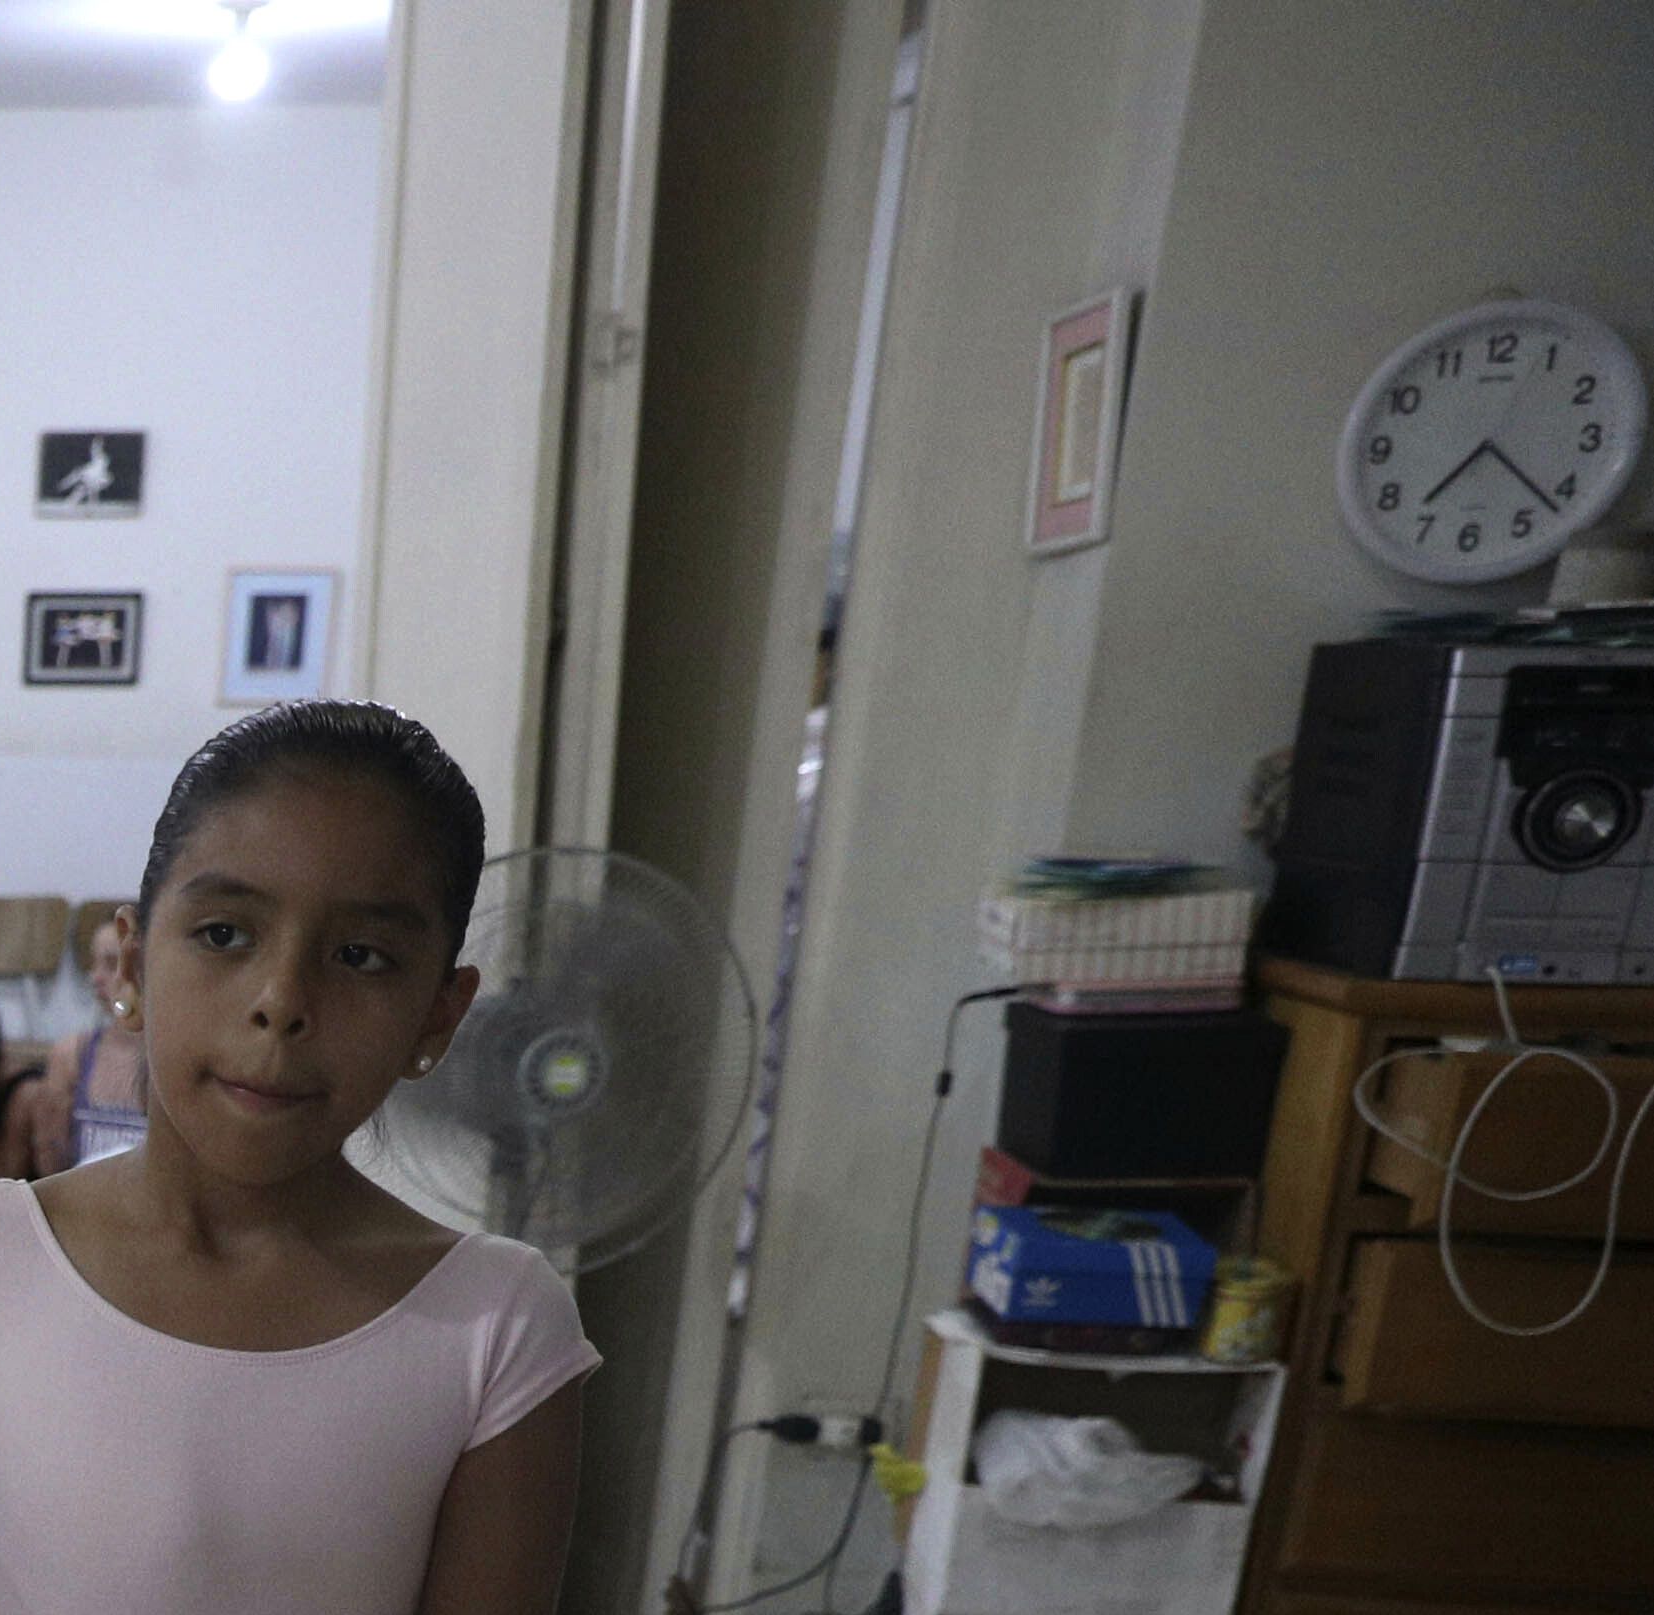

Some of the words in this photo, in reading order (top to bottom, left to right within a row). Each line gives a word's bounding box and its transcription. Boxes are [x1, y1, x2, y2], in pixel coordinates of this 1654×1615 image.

[1487, 333, 1519, 364] 12
[1547, 344, 1558, 371] 1
[1438, 350, 1462, 378] 11
[1389, 386, 1421, 415] 10
[1572, 375, 1597, 405] 2
[1370, 436, 1393, 465] 9
[1580, 423, 1603, 454] 3
[1378, 482, 1401, 511] 8
[1554, 473, 1576, 500] 4
[1416, 515, 1436, 545] 7
[1458, 523, 1481, 553] 6
[1511, 509, 1535, 538] 5
